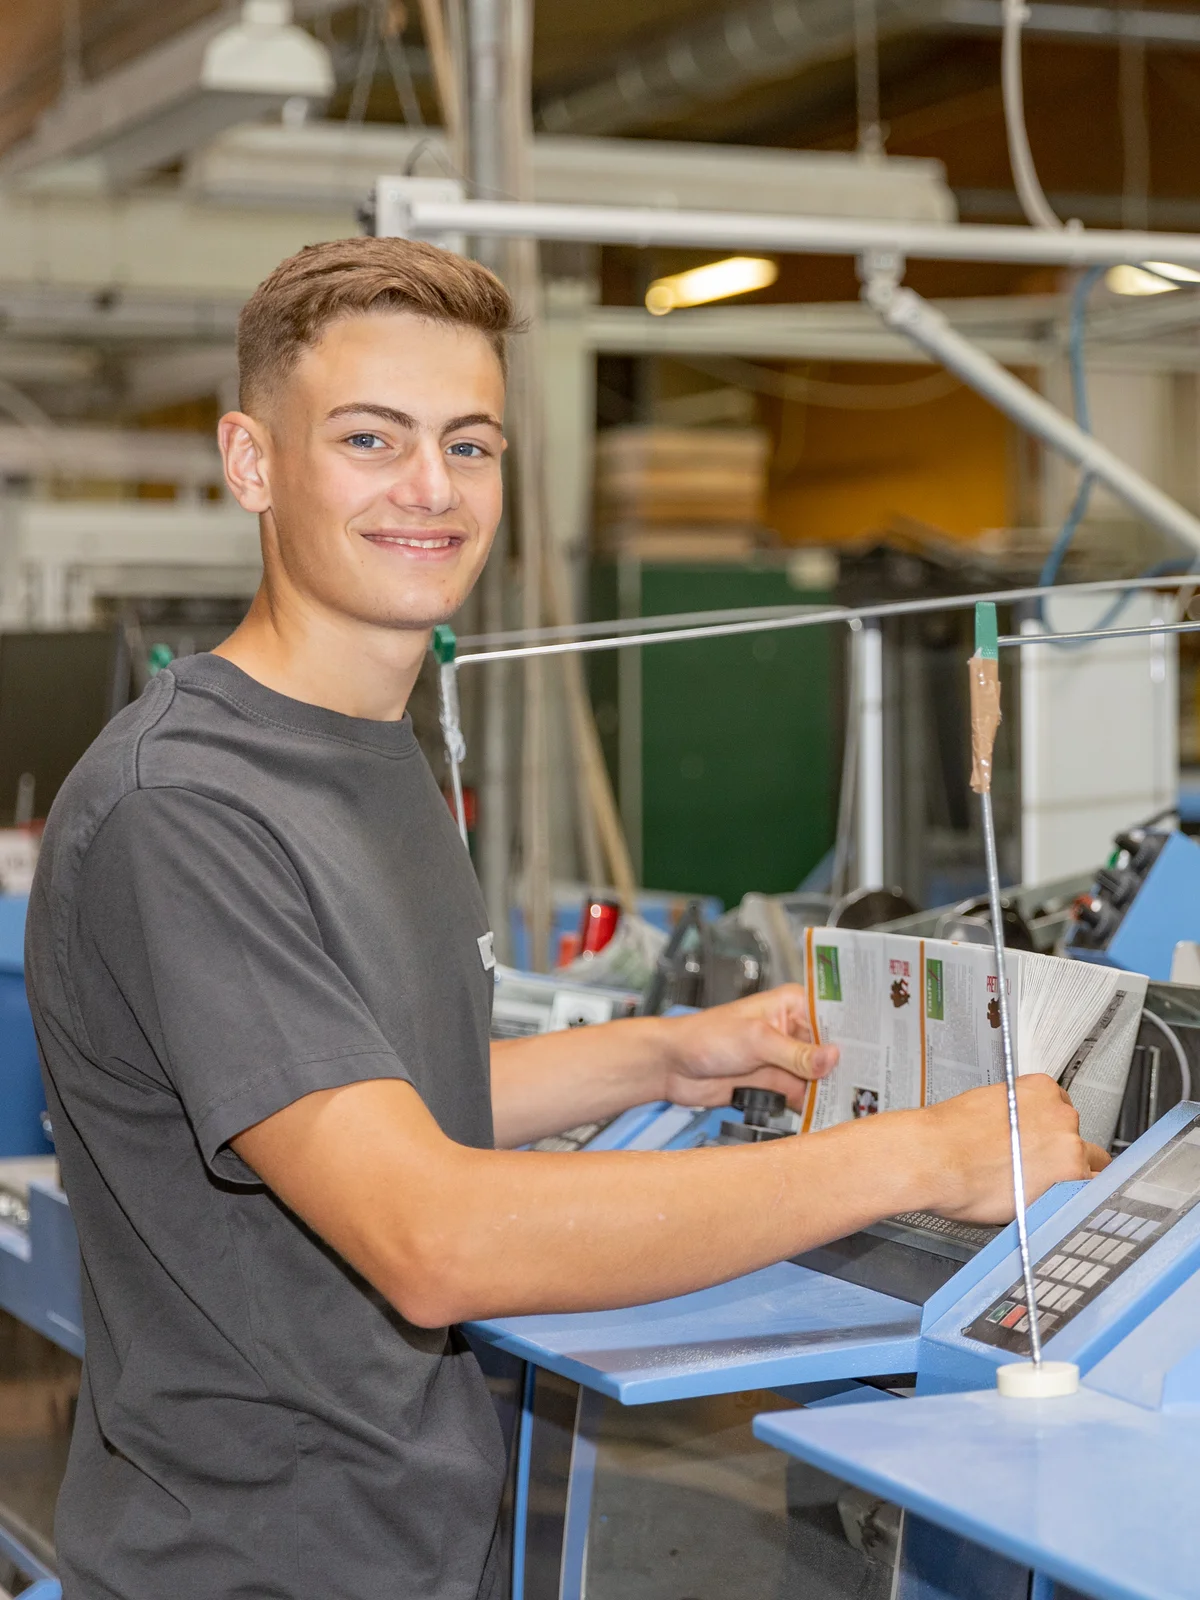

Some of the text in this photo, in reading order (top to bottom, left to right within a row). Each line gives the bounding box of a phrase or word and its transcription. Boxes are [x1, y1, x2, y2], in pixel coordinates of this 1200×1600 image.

[906, 1212, 921, 1224] 240
[912, 1214, 927, 1226] 260
[918, 1215, 933, 1227] 280
[924, 1217, 939, 1228] 300
[930, 1219, 945, 1231] 320
[936, 1221, 951, 1232] 340
